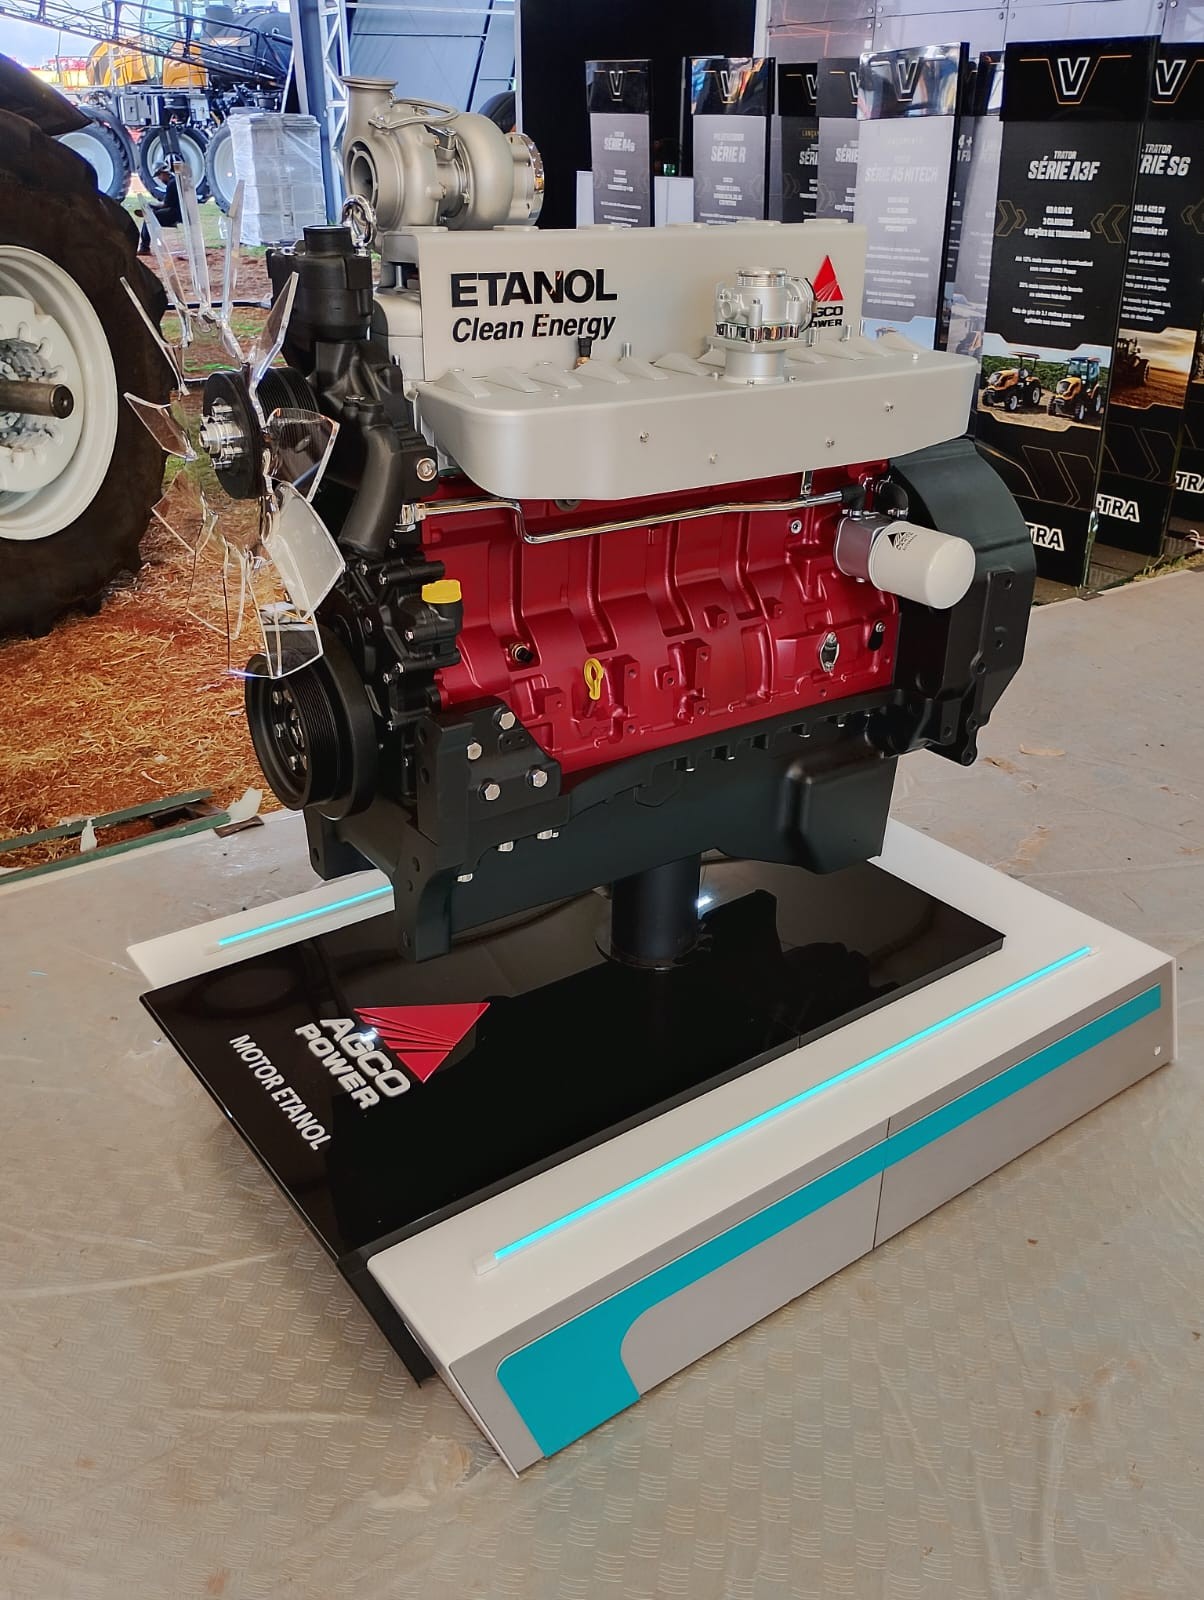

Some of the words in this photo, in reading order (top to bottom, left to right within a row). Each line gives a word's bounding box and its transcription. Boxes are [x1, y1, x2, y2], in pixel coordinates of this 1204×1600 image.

[1056, 57, 1090, 96] V
[711, 141, 738, 163] SÉRIE
[738, 146, 747, 163] R
[1054, 150, 1078, 160] TRATOR
[1145, 143, 1173, 155] TRATOR
[1027, 155, 1070, 181] SÉRIE
[1069, 160, 1101, 182] A3F
[1139, 154, 1168, 176] RIE
[1167, 156, 1191, 176] S6
[450, 268, 618, 308] ETANOL
[811, 319, 843, 328] OWER
[812, 305, 844, 318] GCO
[451, 315, 525, 343] Clean
[532, 312, 617, 342] Energy
[294, 1022, 381, 1110] POWER
[319, 1017, 411, 1098] AGCO
[229, 1034, 284, 1091] MOTOR
[271, 1085, 332, 1151] ETANOL
